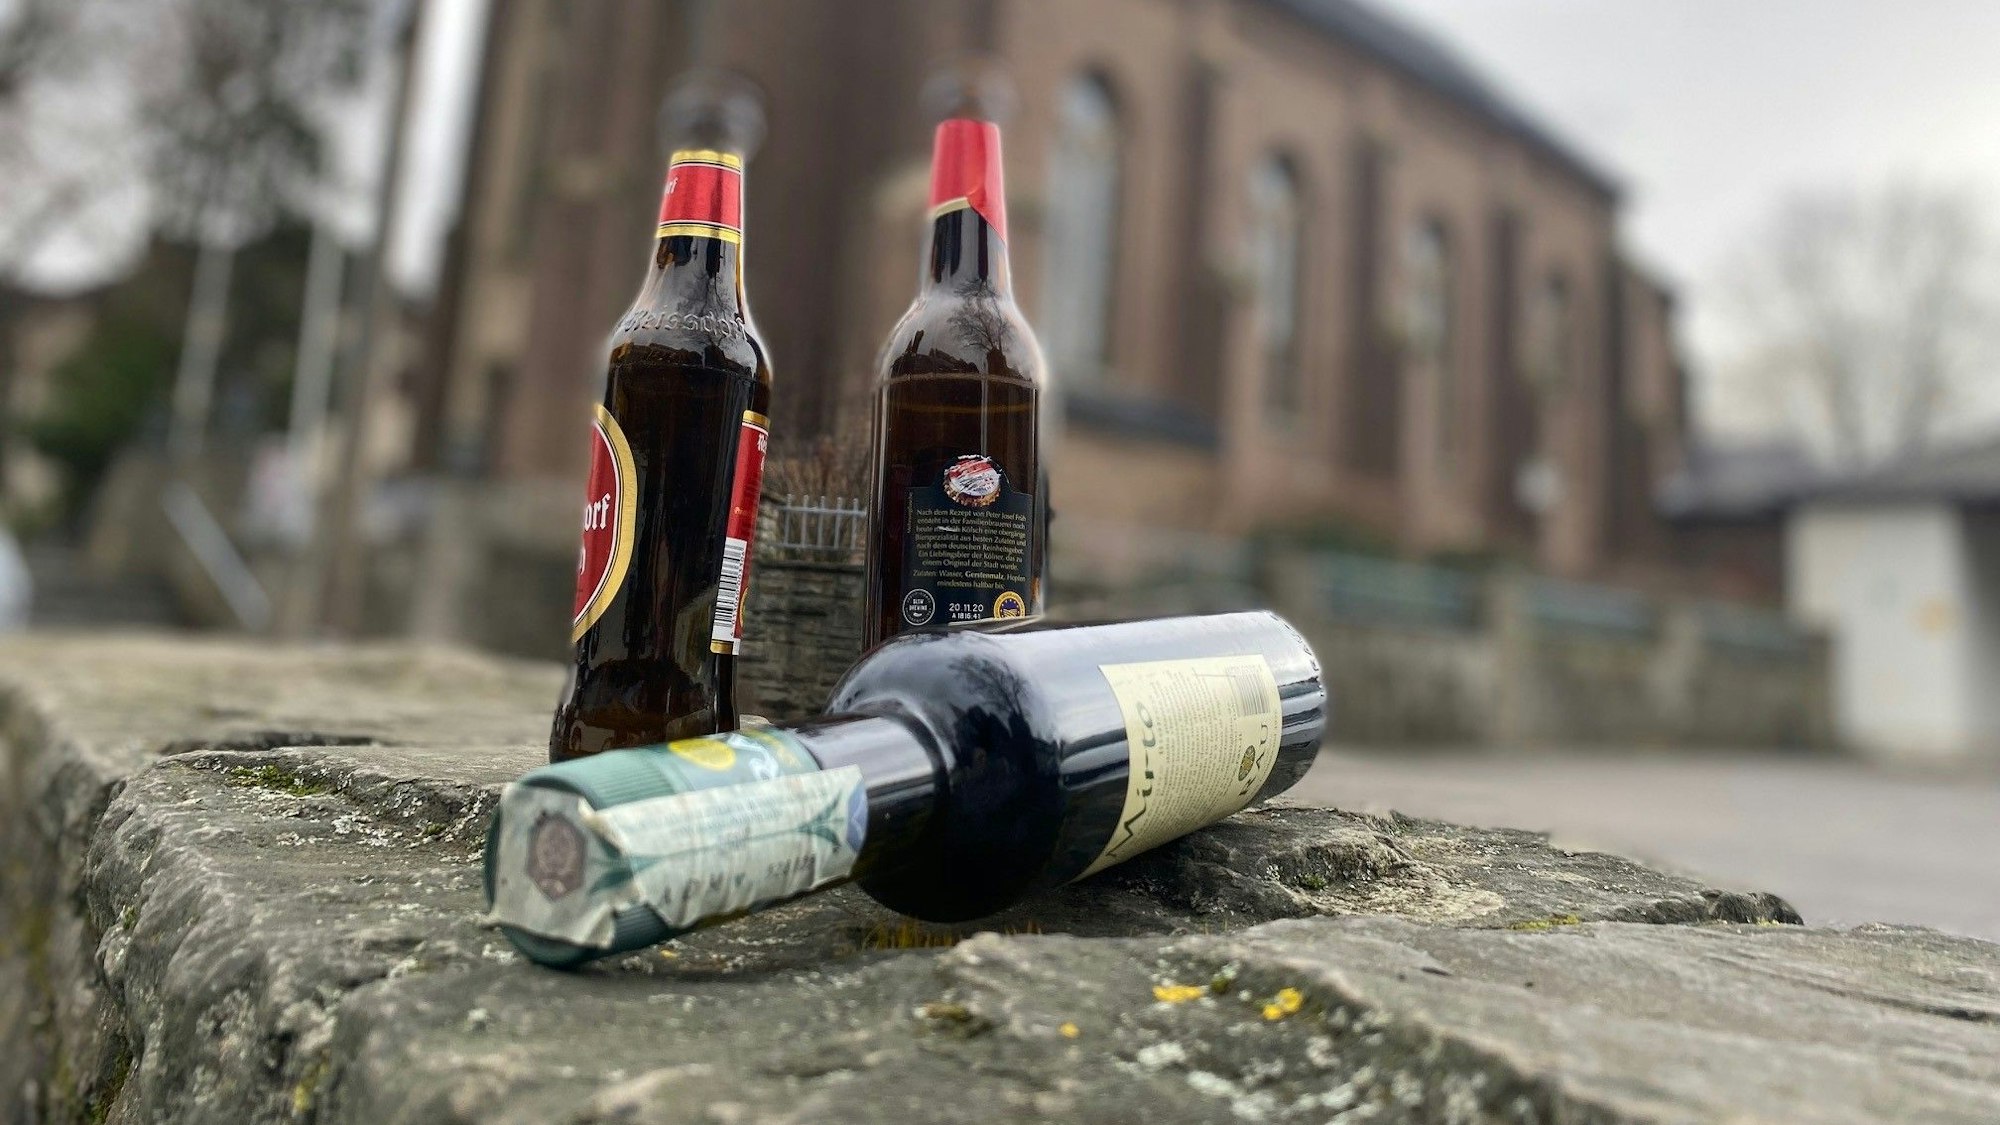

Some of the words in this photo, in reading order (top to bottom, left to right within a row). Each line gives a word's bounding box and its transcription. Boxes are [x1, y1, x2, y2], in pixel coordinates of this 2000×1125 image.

[949, 509, 971, 518] Rezept
[1002, 512, 1015, 520] Josef
[950, 517, 961, 525] der
[963, 518, 1011, 528] Familienbrauerei
[1013, 522, 1026, 530] noch
[962, 526, 982, 534] Kölsch
[973, 534, 992, 543] besten
[994, 537, 1015, 545] Zutaten
[1016, 539, 1027, 547] und
[948, 542, 980, 551] deutschen
[930, 550, 970, 560] Lieblingsbier
[972, 551, 981, 559] der
[1005, 554, 1016, 562] das
[943, 559, 970, 568] Original
[984, 560, 998, 569] Stadt
[936, 580, 972, 588] mindestens
[949, 602, 984, 612] 20.11.20
